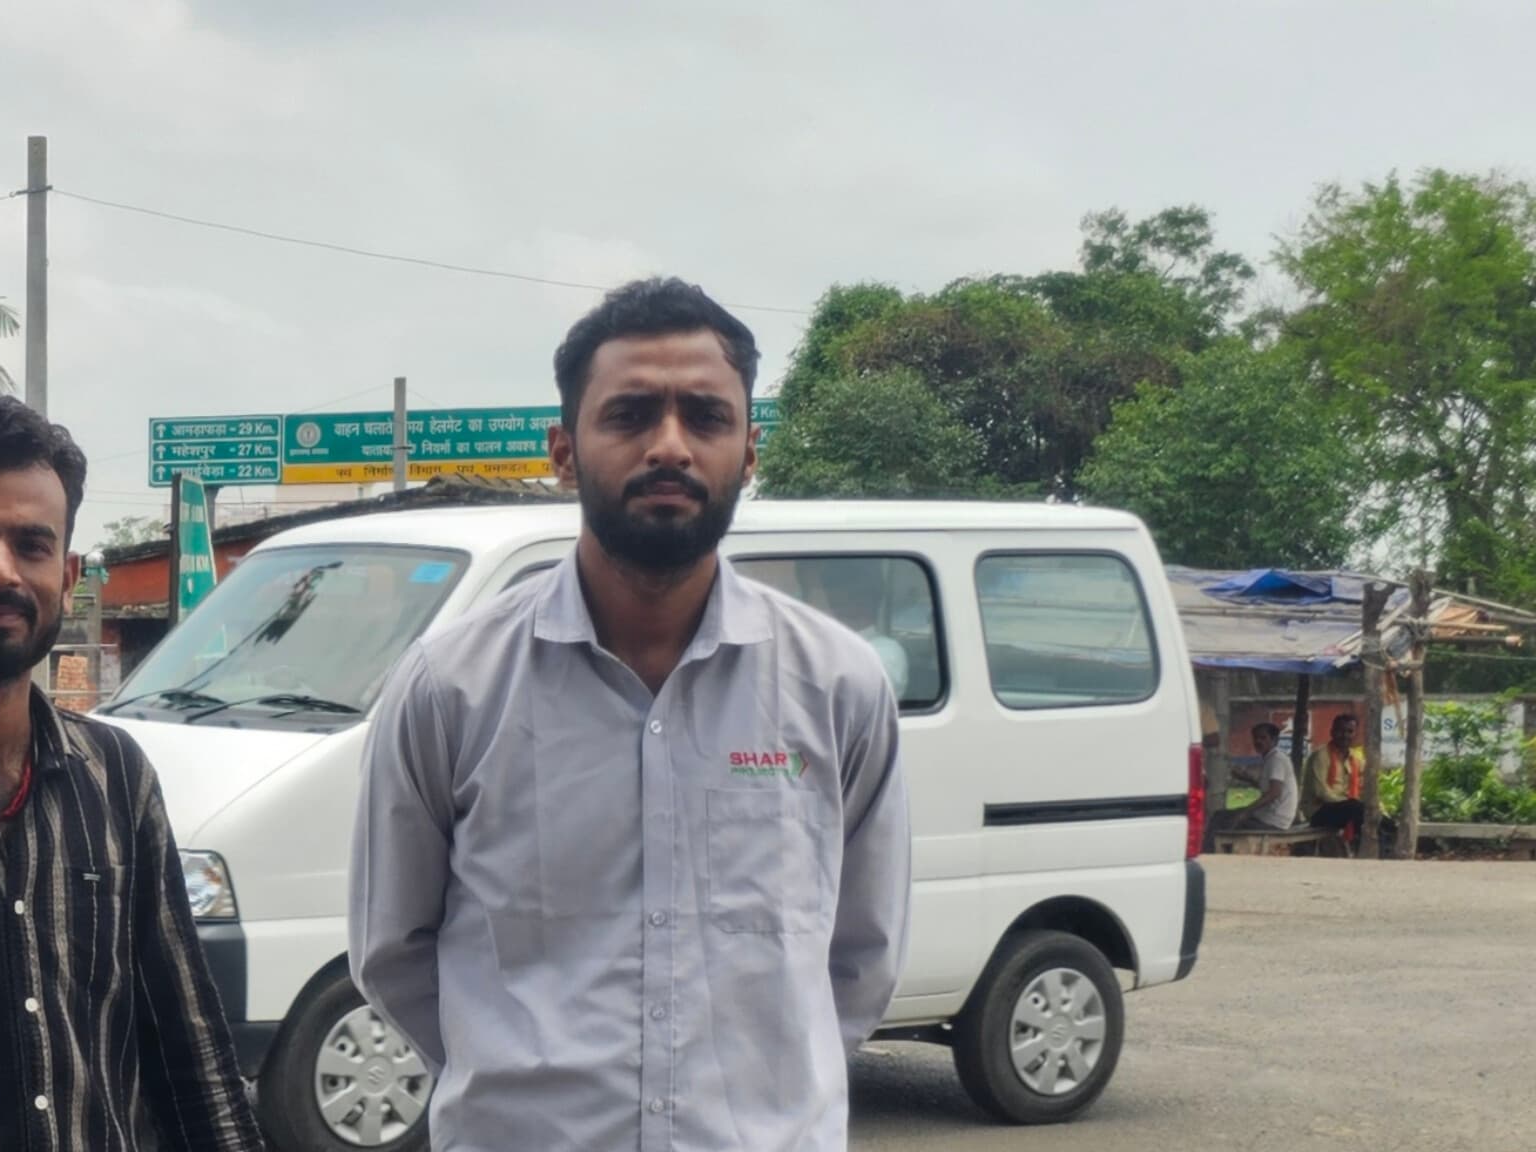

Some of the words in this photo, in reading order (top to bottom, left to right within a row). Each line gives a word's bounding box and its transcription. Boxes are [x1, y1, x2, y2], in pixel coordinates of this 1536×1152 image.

[238, 422, 253, 435] 29
[334, 422, 360, 438] वाहन
[405, 420, 424, 434] मय
[429, 415, 463, 435] हेलमेट
[468, 418, 482, 432] का
[488, 414, 525, 432] उपयोग
[237, 444, 253, 456] 27
[361, 443, 394, 456] याताया
[421, 439, 452, 454] नियमों
[456, 442, 470, 453] का
[474, 441, 502, 452] पालन
[237, 464, 253, 477] 22
